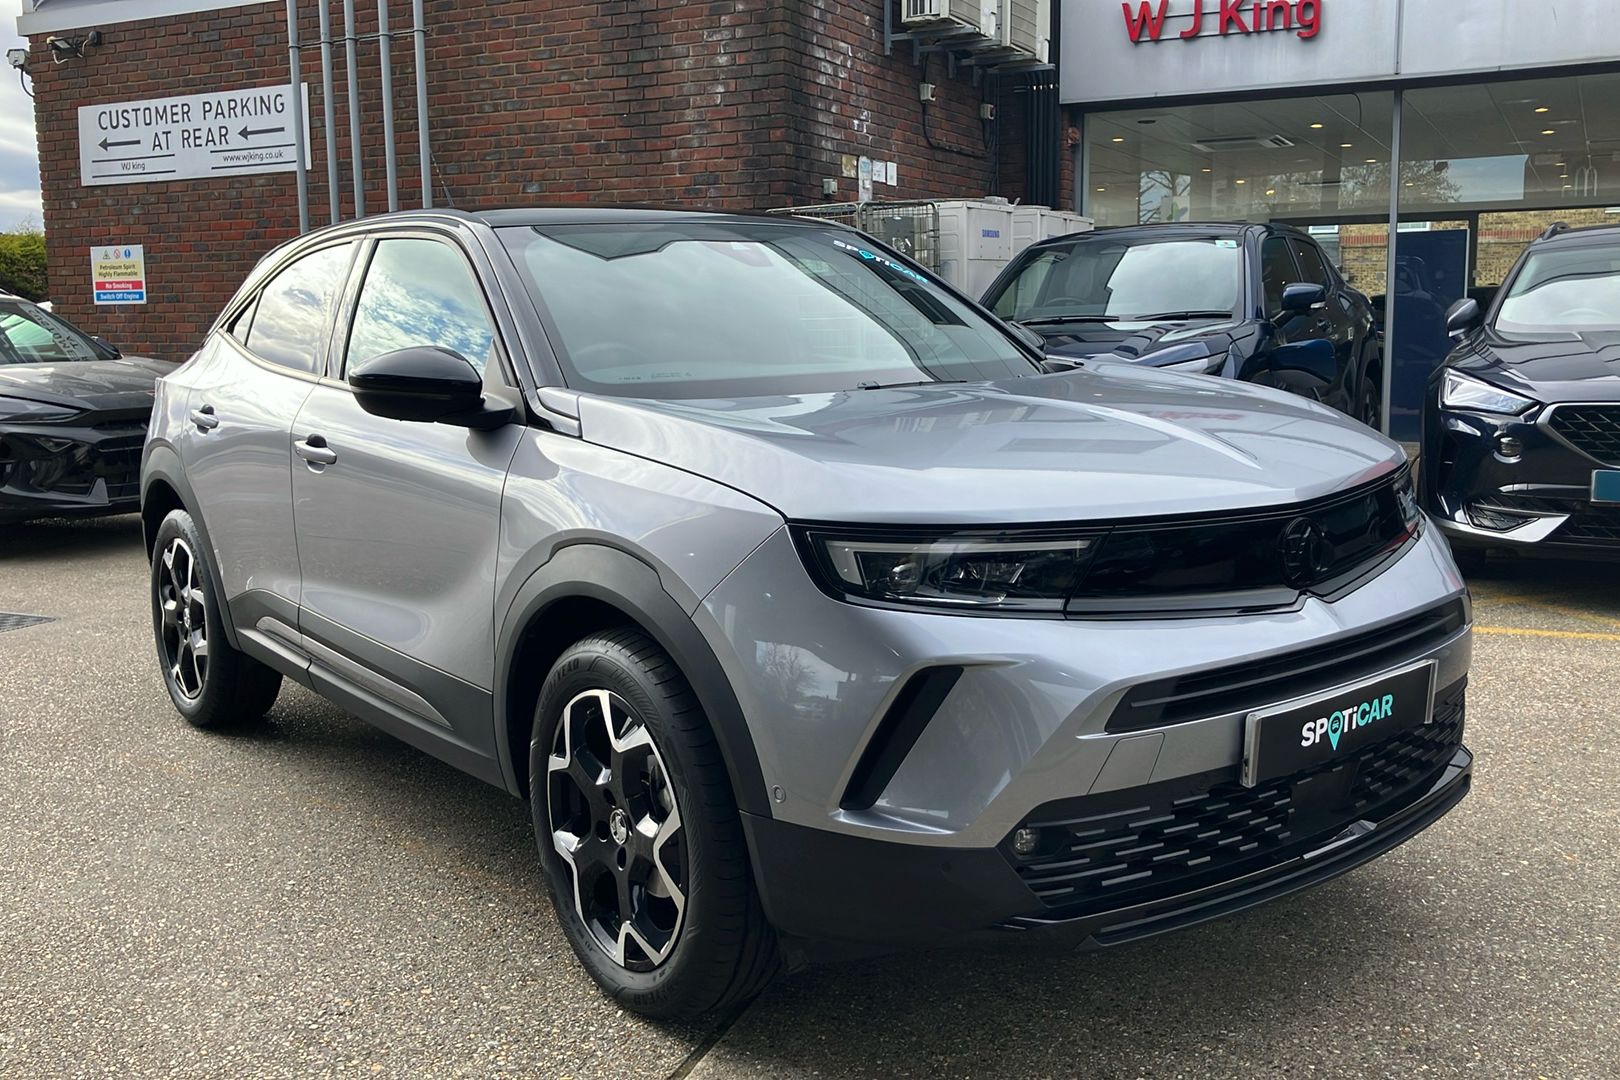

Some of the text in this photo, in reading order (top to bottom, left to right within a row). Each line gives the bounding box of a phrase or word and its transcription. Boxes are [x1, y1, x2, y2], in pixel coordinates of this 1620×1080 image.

[1122, 0, 1322, 42] W J King
[98, 93, 285, 130] CUSTOMER PARKING
[152, 125, 229, 151] AT REAR
[222, 150, 284, 162] www.wjking.co.uk
[121, 161, 146, 171] WJ king
[982, 229, 1000, 239] SAMSUNG
[123, 263, 136, 271] Spirit
[98, 271, 112, 279] Highly
[112, 282, 132, 290] Smoking
[123, 292, 140, 301] Engine
